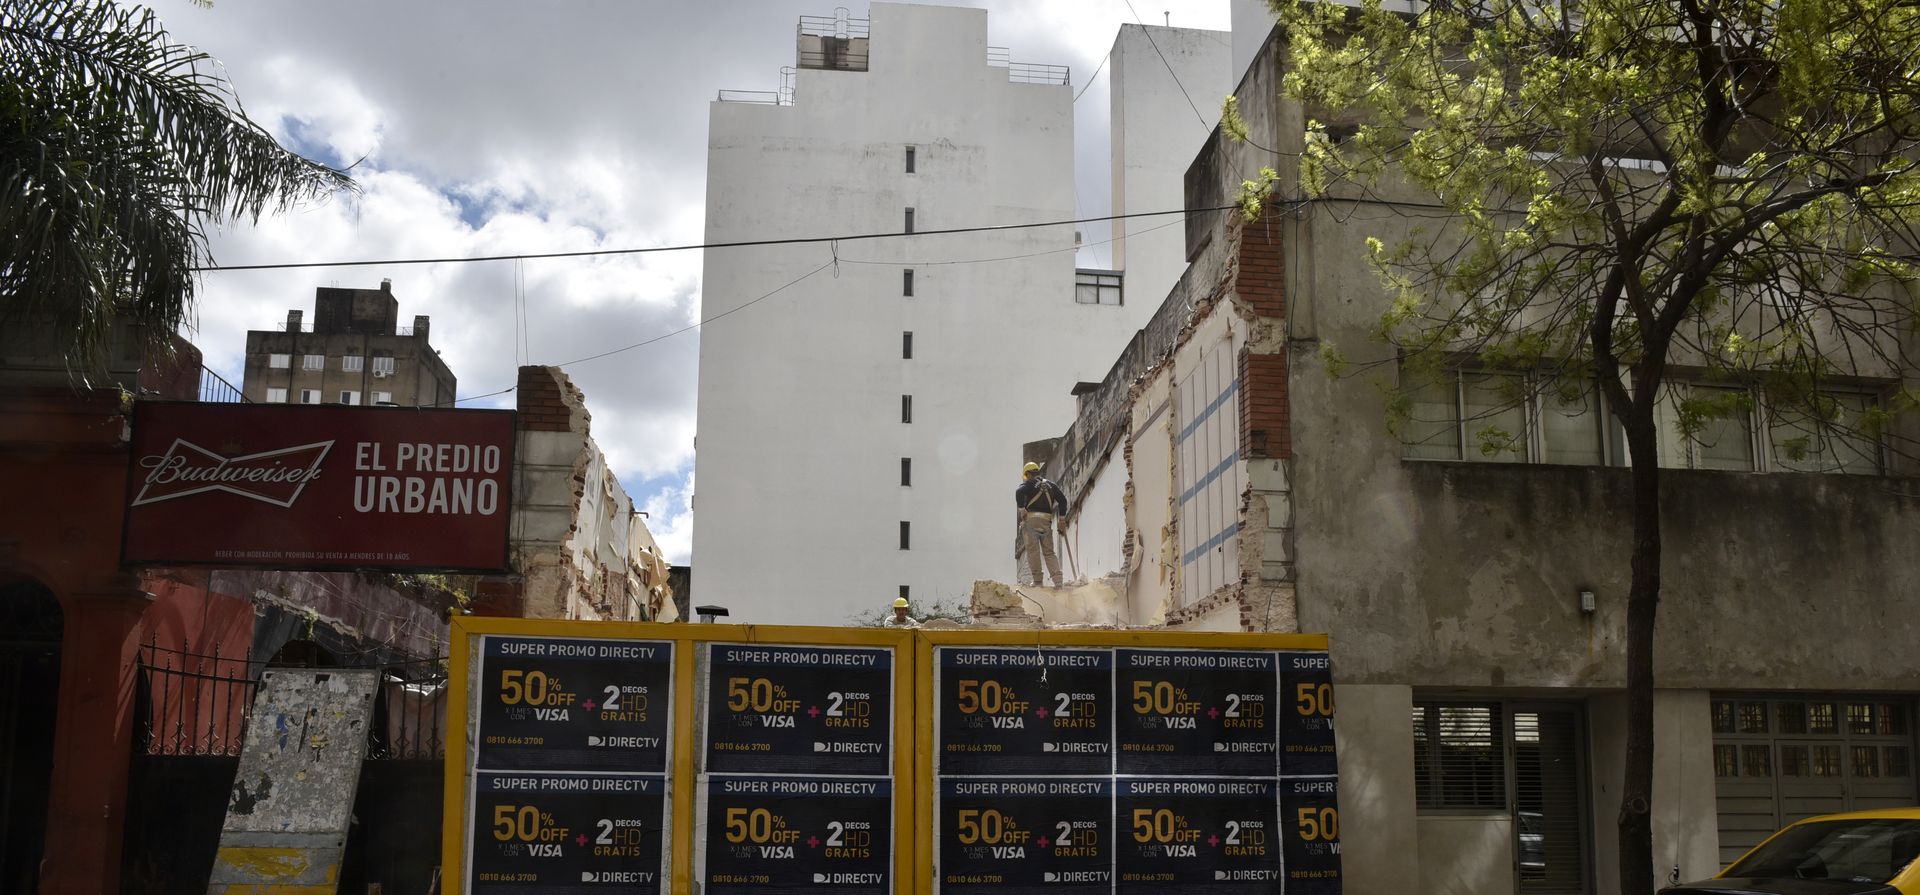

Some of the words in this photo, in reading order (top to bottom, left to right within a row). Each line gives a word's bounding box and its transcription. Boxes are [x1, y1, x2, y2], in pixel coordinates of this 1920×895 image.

[355, 442, 386, 471] EL
[396, 443, 500, 473] PREDIO
[140, 455, 320, 484] Budweiser
[353, 476, 498, 515] URBANO
[501, 643, 545, 655] SUPER
[549, 645, 596, 657] PROMO
[600, 646, 655, 659] DIRECTV
[728, 651, 770, 662] SUPER
[774, 652, 819, 664] PROMO
[823, 654, 876, 665] DIRECTV
[956, 654, 997, 664] SUPER
[1001, 654, 1044, 666] PROMO
[1049, 656, 1099, 666] DIRECTV
[1131, 655, 1170, 666] SUPER
[1174, 656, 1215, 667] PROMO
[1219, 657, 1268, 668] DIRECTV
[548, 693, 576, 706] OFF
[603, 685, 620, 710] 2
[621, 696, 648, 710] HD
[1297, 683, 1333, 716] 50
[774, 700, 800, 712] OFF
[827, 692, 843, 716] 2
[845, 702, 870, 717] HD
[1003, 702, 1029, 714] OFF
[1054, 693, 1070, 717] 2
[1072, 702, 1096, 716] HD
[1176, 703, 1200, 714] OFF
[1225, 694, 1240, 717] 2
[1242, 703, 1264, 717] HD
[533, 708, 569, 721] VISA
[601, 712, 646, 721] GRATIS
[760, 715, 795, 728] VISA
[826, 718, 870, 728] GRATIS
[991, 717, 1024, 728] VISA
[1054, 719, 1096, 727] GRATIS
[1164, 717, 1196, 728] VISA
[1224, 719, 1264, 728] GRATIS
[609, 737, 659, 747] DIRECTV
[834, 743, 882, 753] DIRECTV
[1063, 743, 1108, 752] DIRECTV
[1232, 743, 1275, 752] DIRECTV
[493, 778, 537, 789] SUPER
[542, 779, 588, 790] PROMO
[593, 780, 648, 791] DIRECTV
[725, 781, 768, 792] SUPER
[773, 782, 818, 793] PROMO
[822, 783, 876, 794] DIRECTV
[956, 783, 998, 794] SUPER
[1002, 784, 1046, 794] PROMO
[1050, 783, 1101, 794] DIRECTV
[1131, 783, 1170, 794] SUPER
[1174, 783, 1215, 794] PROMO
[1219, 784, 1267, 794] DIRECTV
[1294, 782, 1333, 792] SUPER
[1298, 808, 1338, 840] 50
[541, 828, 569, 841] OFF
[596, 819, 613, 845] 2
[615, 829, 641, 845] HD
[773, 831, 800, 843] OFF
[826, 822, 843, 846] 2
[1003, 831, 1030, 843] OFF
[1056, 822, 1072, 846] 2
[1073, 830, 1097, 846] HD
[1176, 830, 1201, 842] OFF
[1225, 821, 1239, 845] 2
[1242, 830, 1264, 844] HD
[845, 832, 870, 847] HD
[527, 844, 562, 857] VISA
[594, 847, 640, 856] GRATIS
[759, 846, 794, 858] VISA
[825, 848, 870, 858] GRATIS
[991, 847, 1025, 859] VISA
[1055, 848, 1097, 856] GRATIS
[1164, 845, 1196, 857] VISA
[1225, 847, 1265, 855] GRATIS
[602, 872, 653, 882] DIRECTV
[734, 875, 747, 883] 666
[834, 874, 882, 884] DIRECTV
[1064, 872, 1110, 882] DIRECTV
[1234, 871, 1278, 880] DIRECTV
